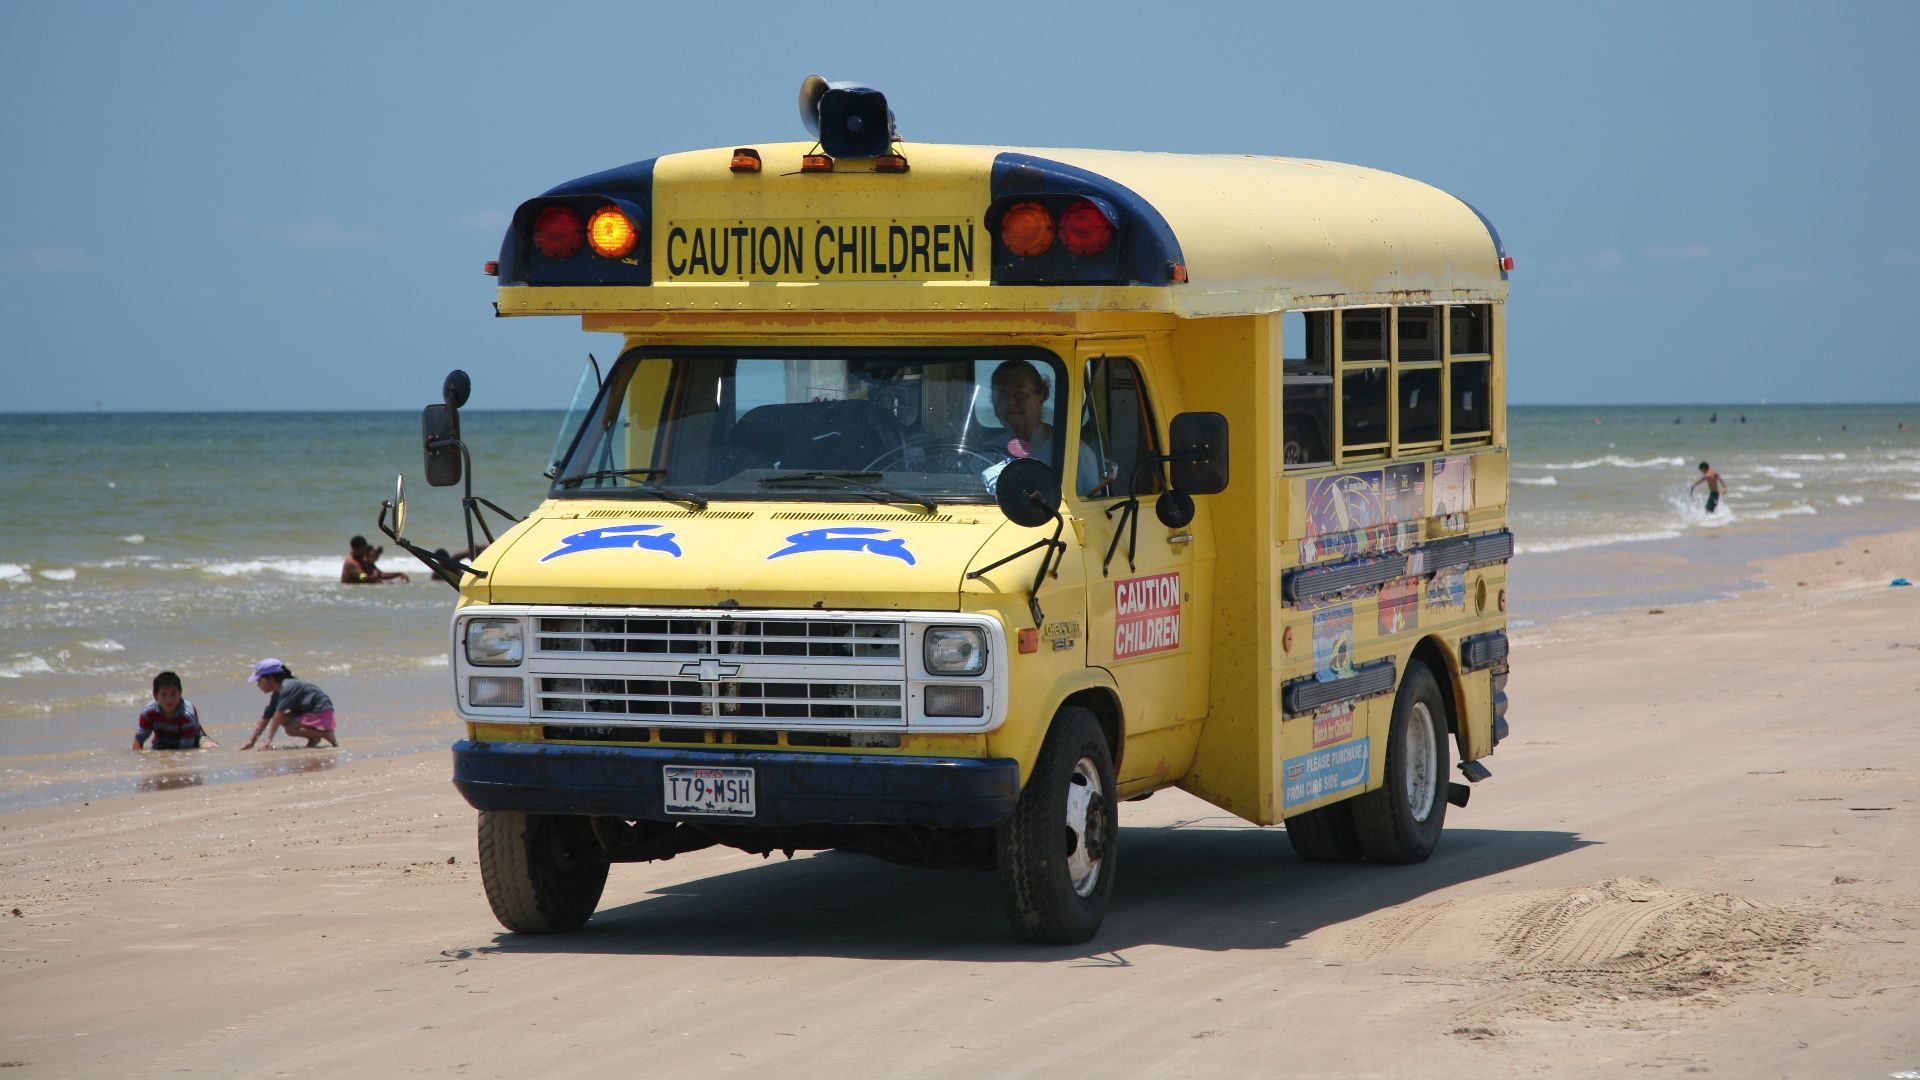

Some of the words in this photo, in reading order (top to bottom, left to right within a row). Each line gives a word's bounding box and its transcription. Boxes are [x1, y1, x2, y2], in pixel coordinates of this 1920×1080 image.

[667, 225, 803, 276] CAUTION
[815, 224, 974, 275] CHILDREN
[1116, 575, 1180, 616] CAUTION
[1116, 614, 1180, 656] CHILDREN
[1306, 753, 1331, 774] PLEASE
[1331, 744, 1363, 767] PURCHASE
[669, 778, 705, 802] T79
[714, 779, 750, 803] MSH
[1286, 783, 1305, 803] FROM
[1305, 777, 1323, 797] CURB
[1323, 773, 1338, 791] SIDE
